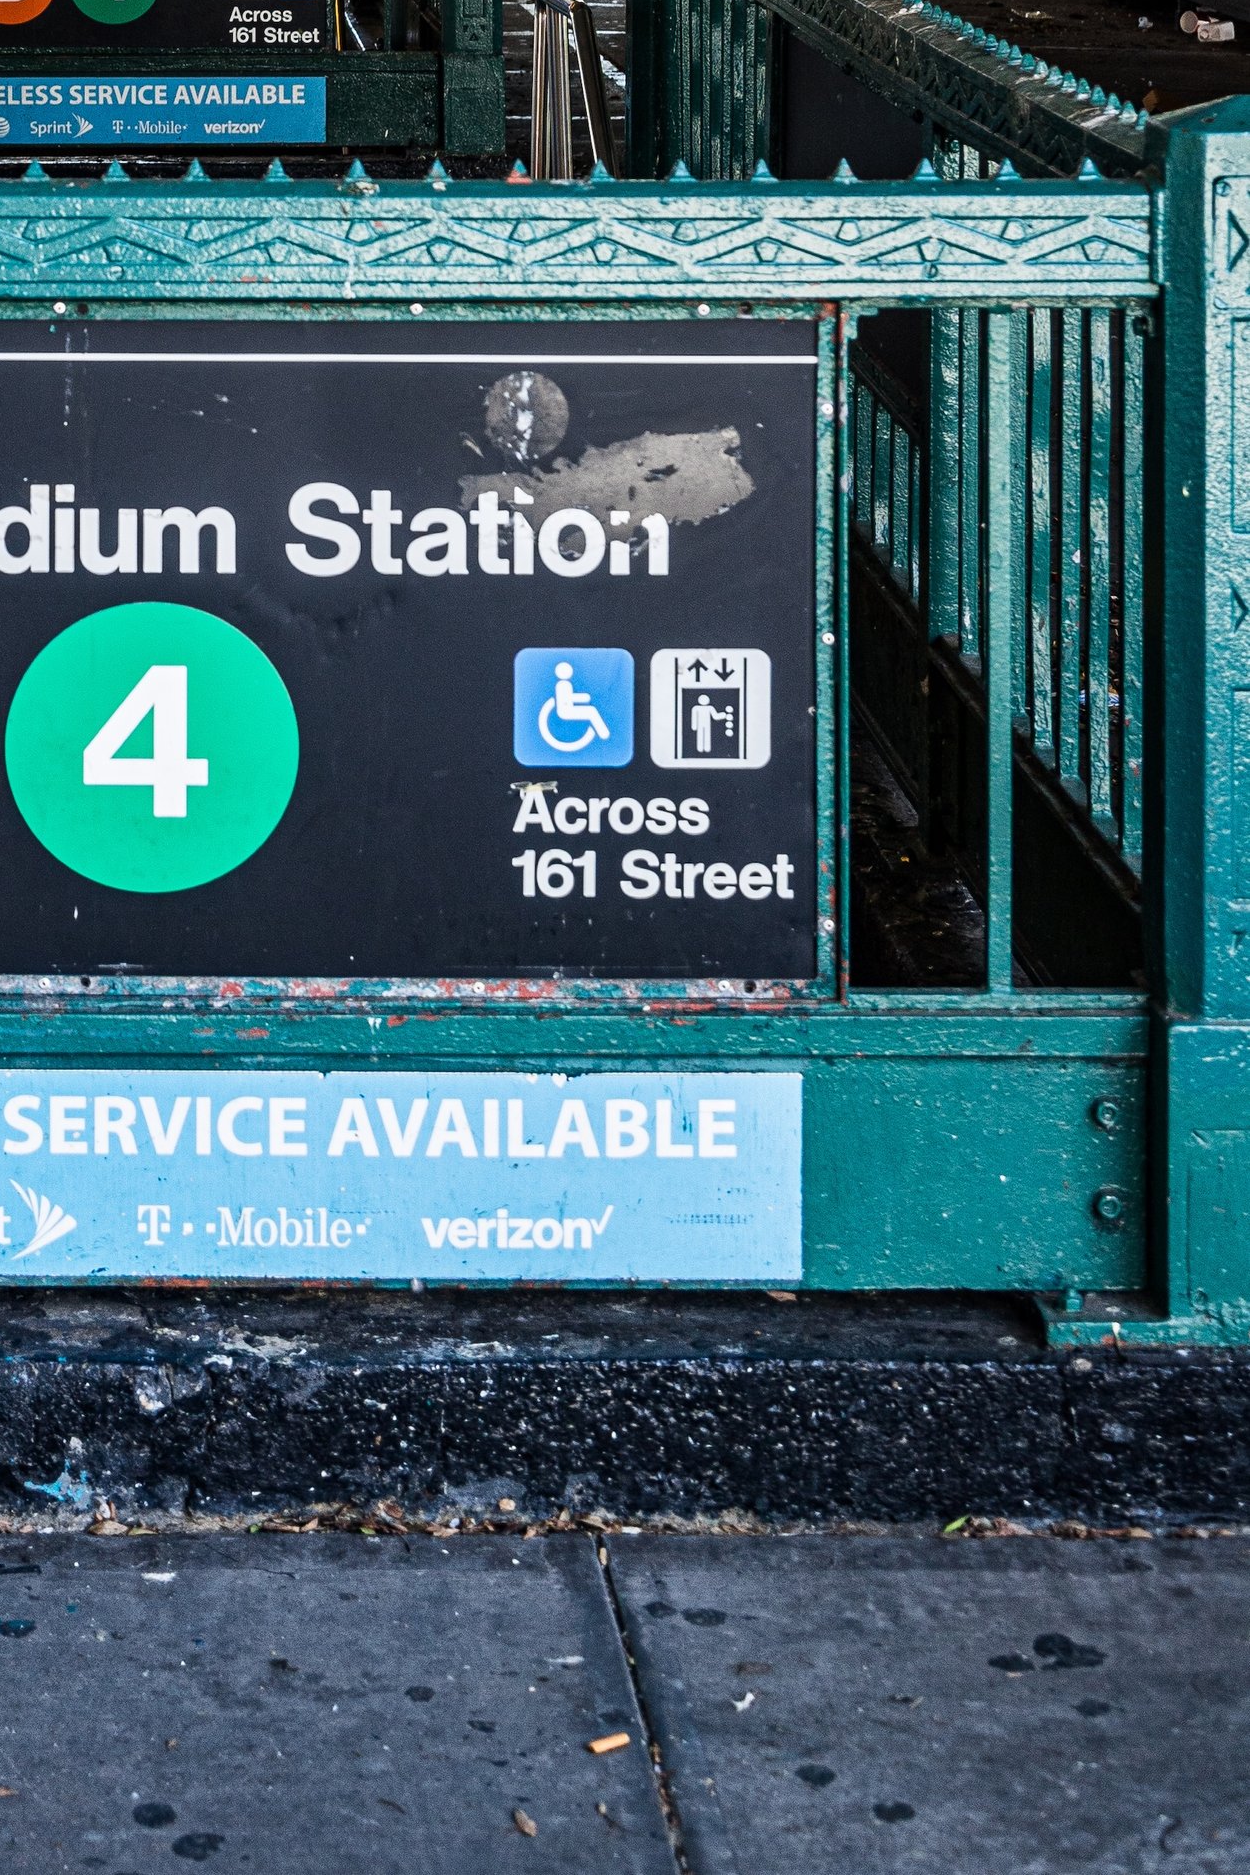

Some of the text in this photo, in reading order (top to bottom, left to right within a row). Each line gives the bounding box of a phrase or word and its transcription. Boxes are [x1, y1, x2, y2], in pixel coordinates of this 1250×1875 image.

[229, 6, 293, 23] Across
[229, 27, 320, 44] 161 Street
[69, 84, 169, 106] SERVICE
[173, 84, 306, 105] AVAILABLE
[29, 120, 72, 137] Sprint
[203, 121, 259, 135] verizon
[284, 482, 670, 578] Station
[82, 664, 210, 819] 4
[512, 788, 711, 835] Across
[511, 849, 796, 900] 161 Street
[2, 1094, 308, 1157] SERVICE
[326, 1096, 739, 1159] AVAILABLE
[421, 1206, 594, 1250] verizon
